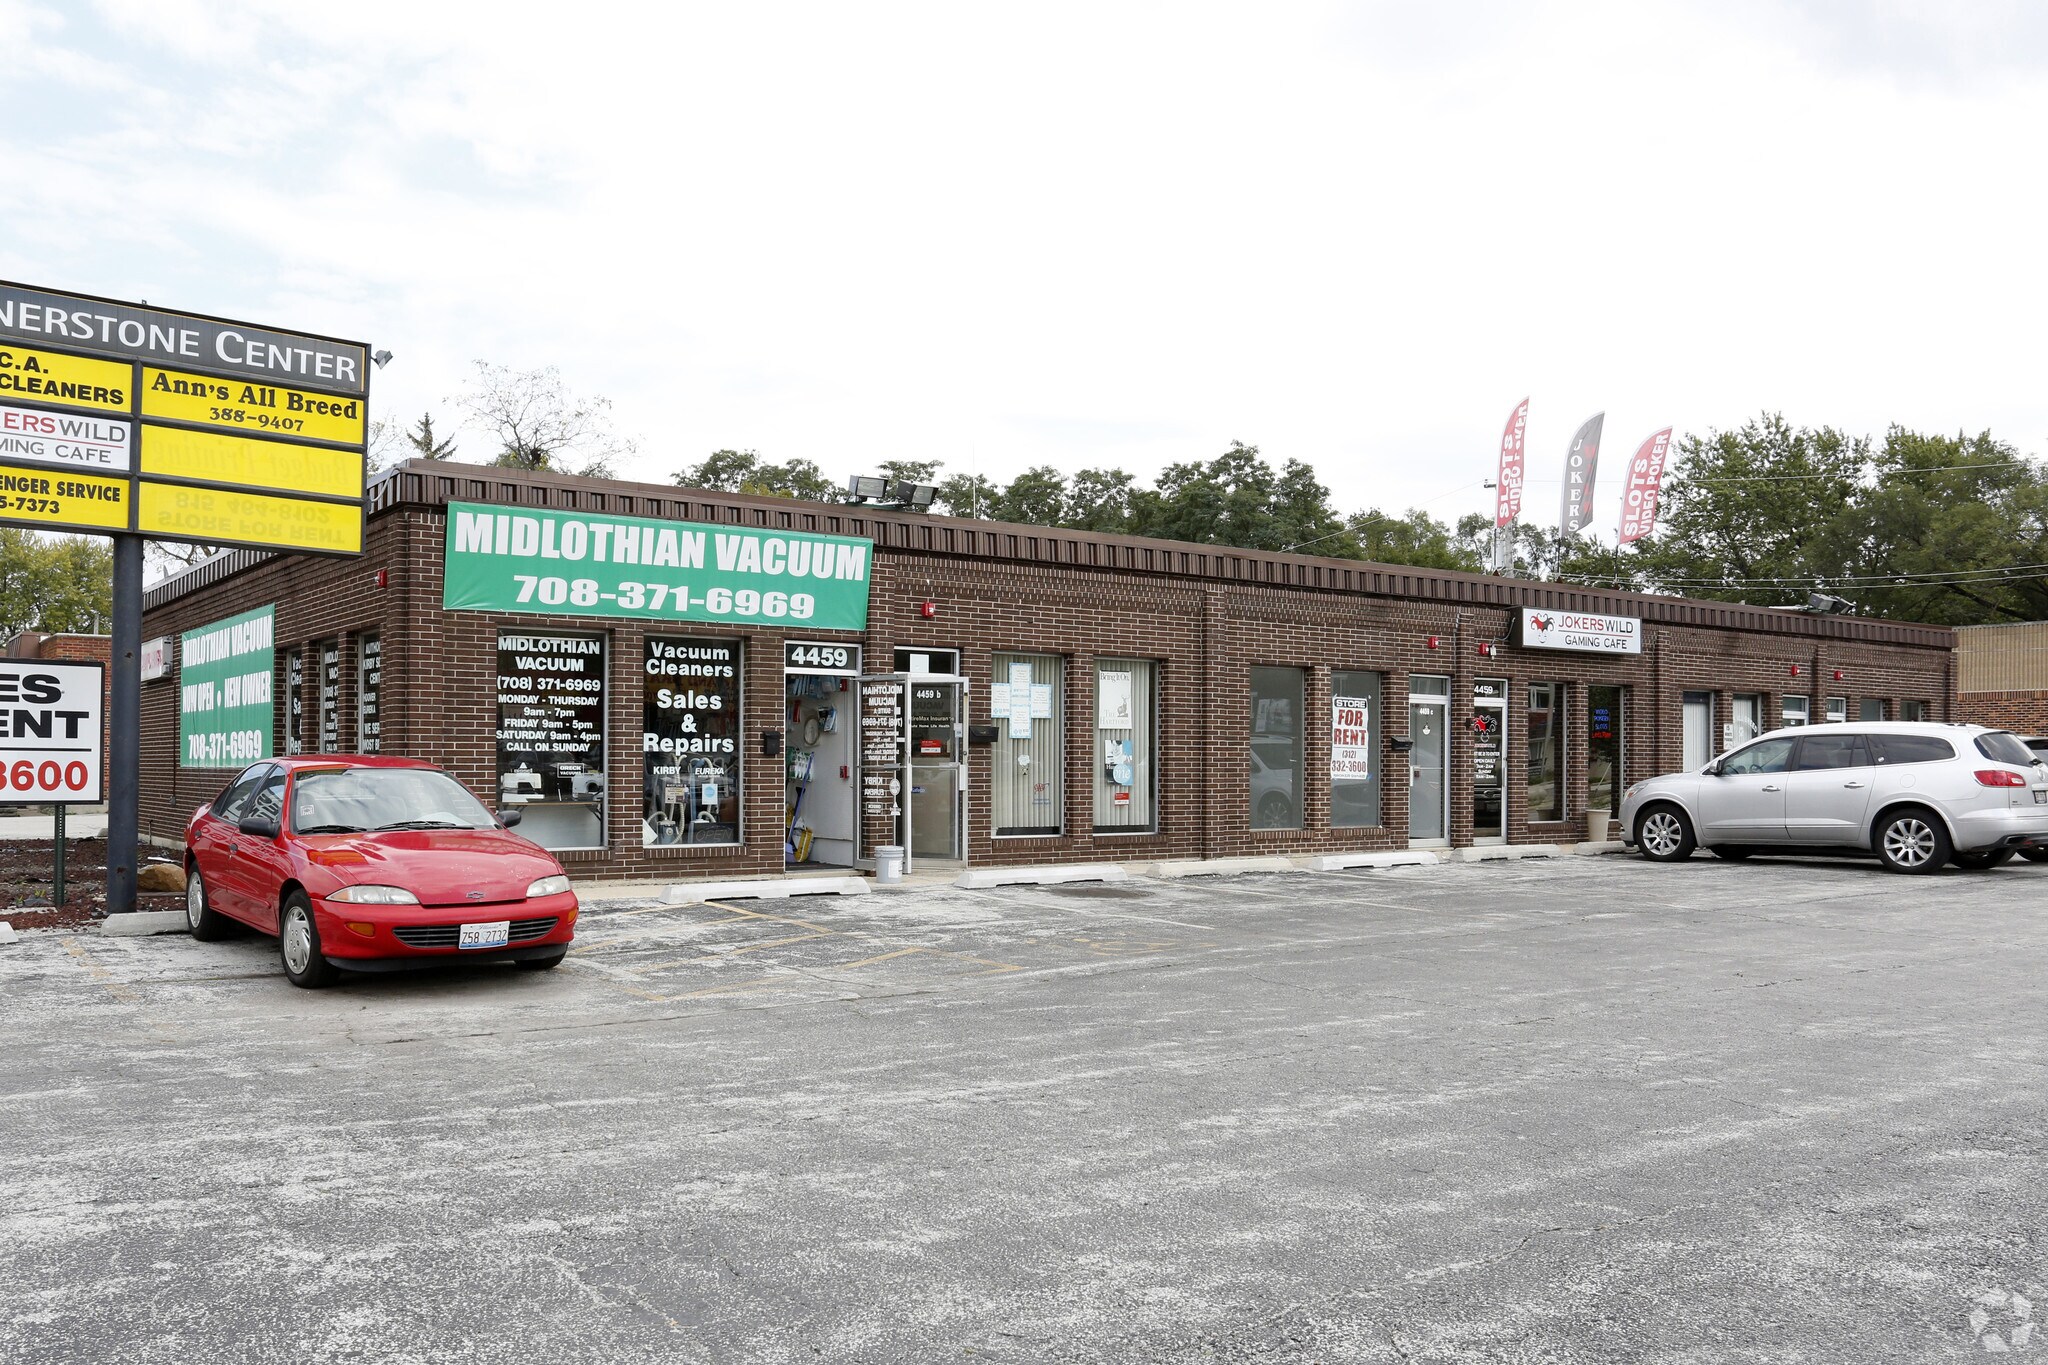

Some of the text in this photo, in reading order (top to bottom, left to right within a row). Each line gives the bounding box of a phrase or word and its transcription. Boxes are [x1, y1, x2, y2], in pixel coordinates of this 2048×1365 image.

[215, 330, 356, 382] CENTER
[0, 373, 124, 405] CLEANERS
[151, 372, 358, 420] Ann's All Breed
[209, 406, 304, 432] 388-9407
[55, 444, 111, 463] CAFE
[1646, 433, 1669, 485] POKER
[1500, 433, 1513, 519] SLOTS
[1568, 439, 1583, 532] JOKERS
[56, 481, 121, 502] SERVICE
[1624, 458, 1648, 536] SLOTS
[1638, 489, 1656, 534] VIDEO
[454, 511, 866, 582] MIDLOTHIAN VACUUM
[512, 574, 815, 620] 708-371-6969
[1558, 615, 1634, 634] JOKERSWILD
[183, 627, 230, 668] MIDLOTHIAN
[231, 614, 273, 657] VACUUM
[498, 637, 600, 655] MIDLOTHIAN
[651, 641, 730, 660] Vacuum
[1565, 635, 1627, 649] GAMING CAFE
[515, 656, 584, 672] VACUUM
[791, 646, 848, 667] 4459
[646, 658, 733, 678] Cleaners
[183, 670, 271, 713] NOW OPEN NEW OWNER
[496, 675, 601, 692] (708) 371-6969
[498, 694, 539, 704] MONDAY
[548, 696, 599, 706] THURSDAY
[656, 688, 722, 710] Sales
[916, 690, 941, 699] 4459 b
[1336, 700, 1366, 708] STORE
[523, 707, 545, 716] 9am
[554, 708, 575, 718] 7pm
[1337, 709, 1364, 727] FOR
[0, 709, 90, 739] NT
[504, 719, 539, 728] FRIDAY
[541, 720, 563, 729] 9am
[572, 720, 593, 731] 5pm
[681, 713, 697, 733] &
[188, 729, 262, 760] 708-371-6969
[496, 730, 547, 740] SATURDAY
[549, 731, 571, 740] 9am
[580, 732, 601, 742] 4pm
[643, 733, 735, 757] Repairs
[1333, 728, 1367, 746] RENT
[506, 742, 591, 752] CALL ON SUNDAY
[653, 766, 681, 775] KIRBY
[694, 767, 725, 775] EUREKA
[1331, 760, 1367, 773] 332-3600
[461, 929, 507, 944] Z58 2732
